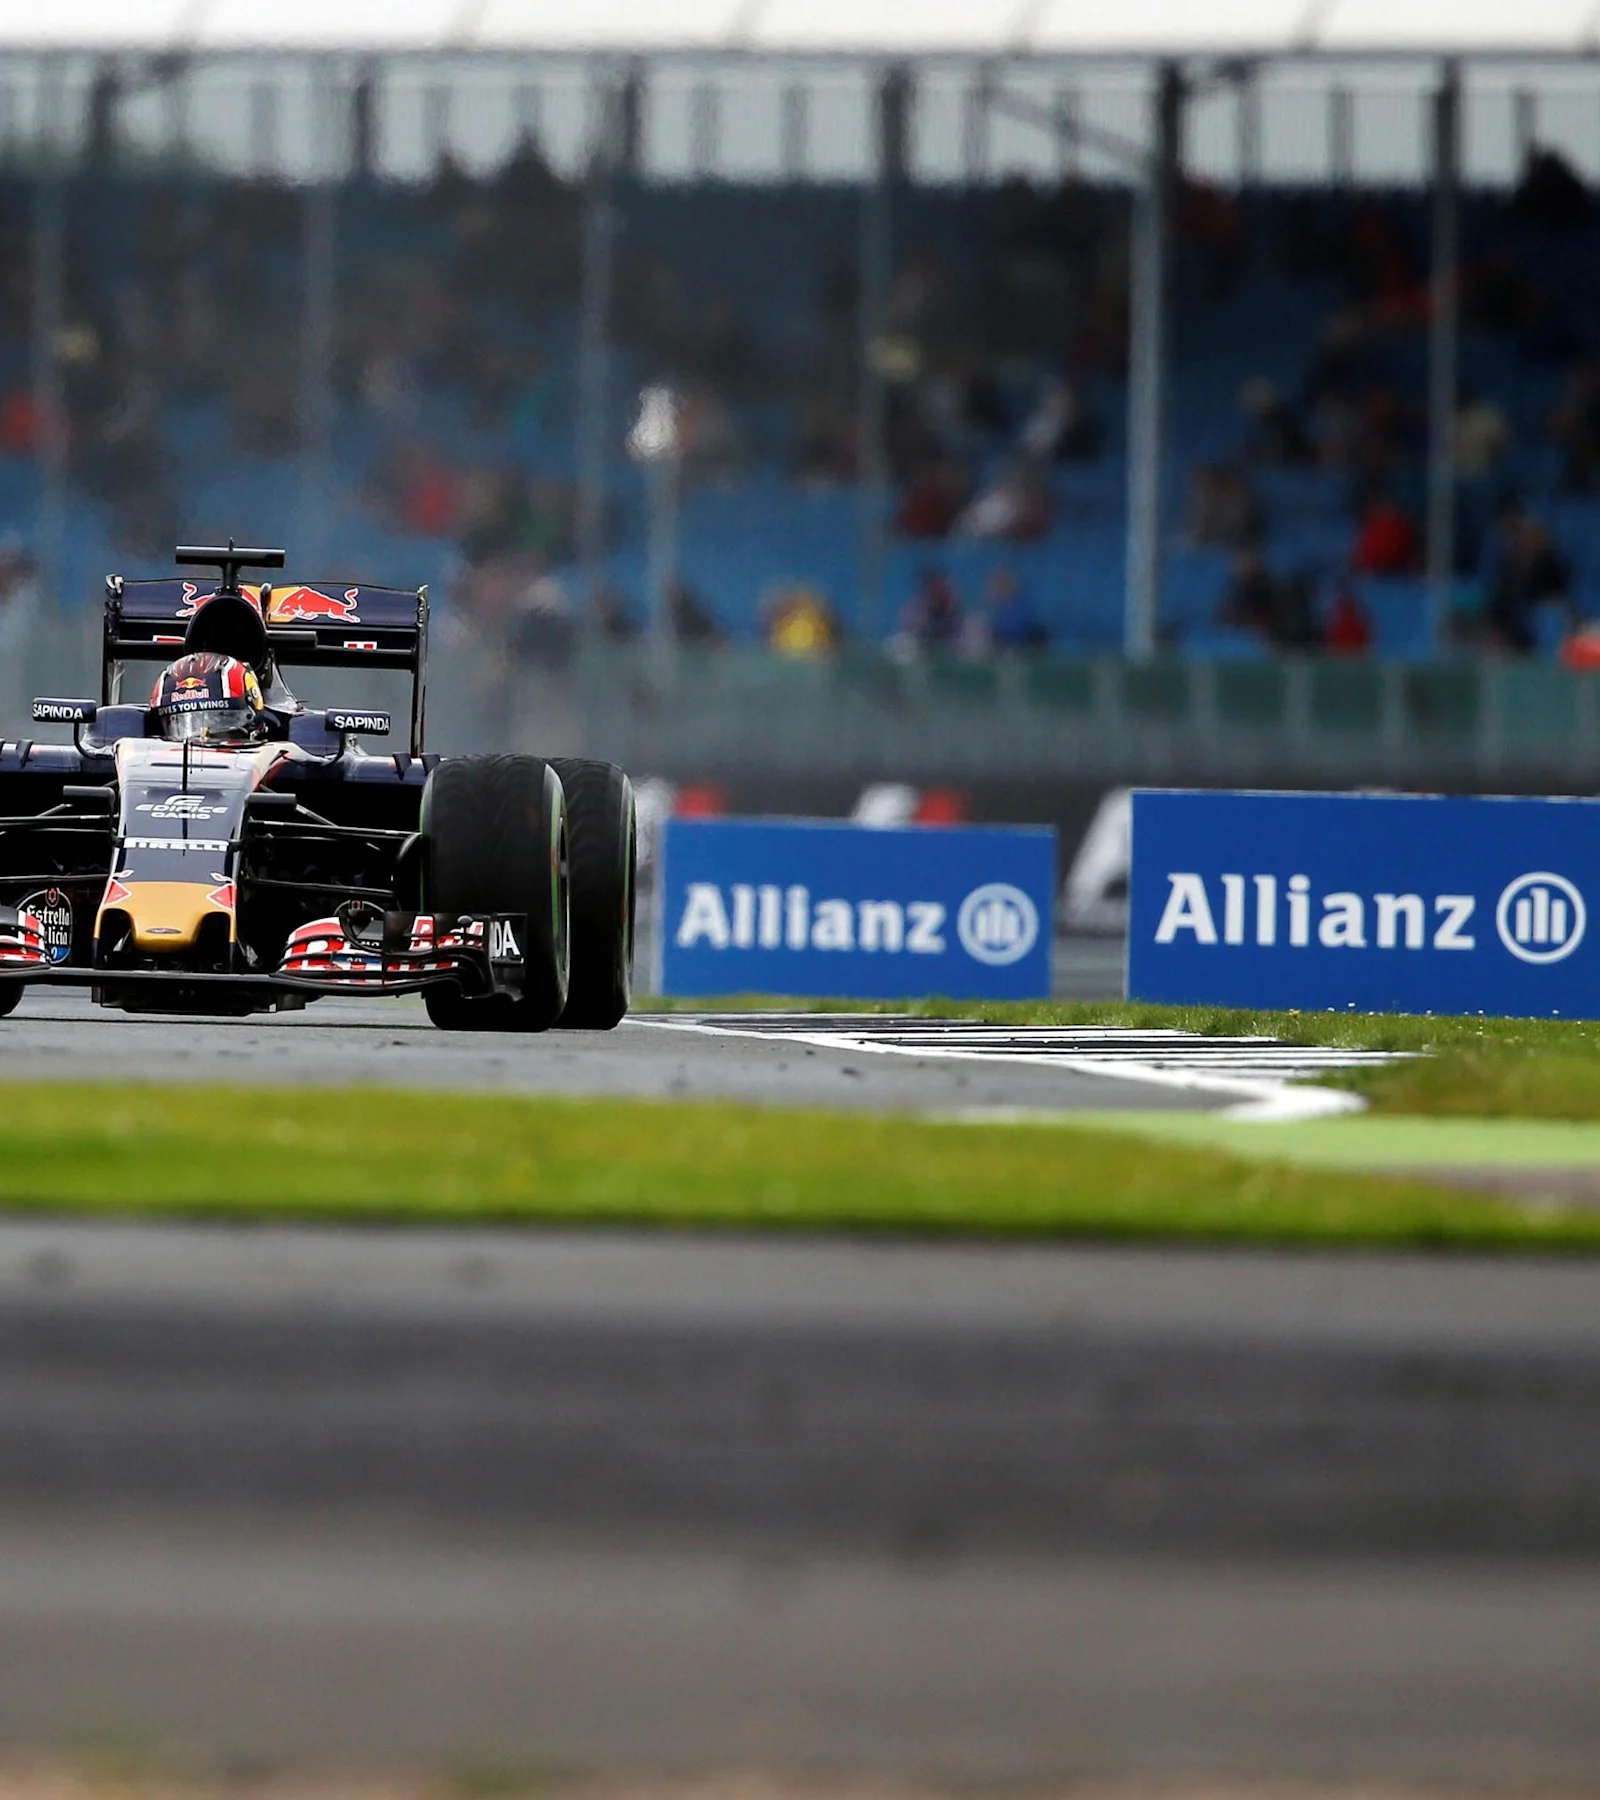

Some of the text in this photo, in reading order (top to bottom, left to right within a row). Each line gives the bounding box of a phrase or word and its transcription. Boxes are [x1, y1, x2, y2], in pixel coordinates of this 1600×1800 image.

[33, 703, 84, 720] SAPINDA
[179, 701, 198, 711] YOU
[199, 699, 230, 710] WINGS
[334, 715, 390, 731] SAPINDA
[151, 812, 211, 820] CASIO
[123, 837, 230, 852] PIRELLI
[26, 904, 70, 926] Estrella
[677, 882, 947, 954] Allianz
[1154, 872, 1476, 950] Allianz
[45, 926, 68, 946] licia
